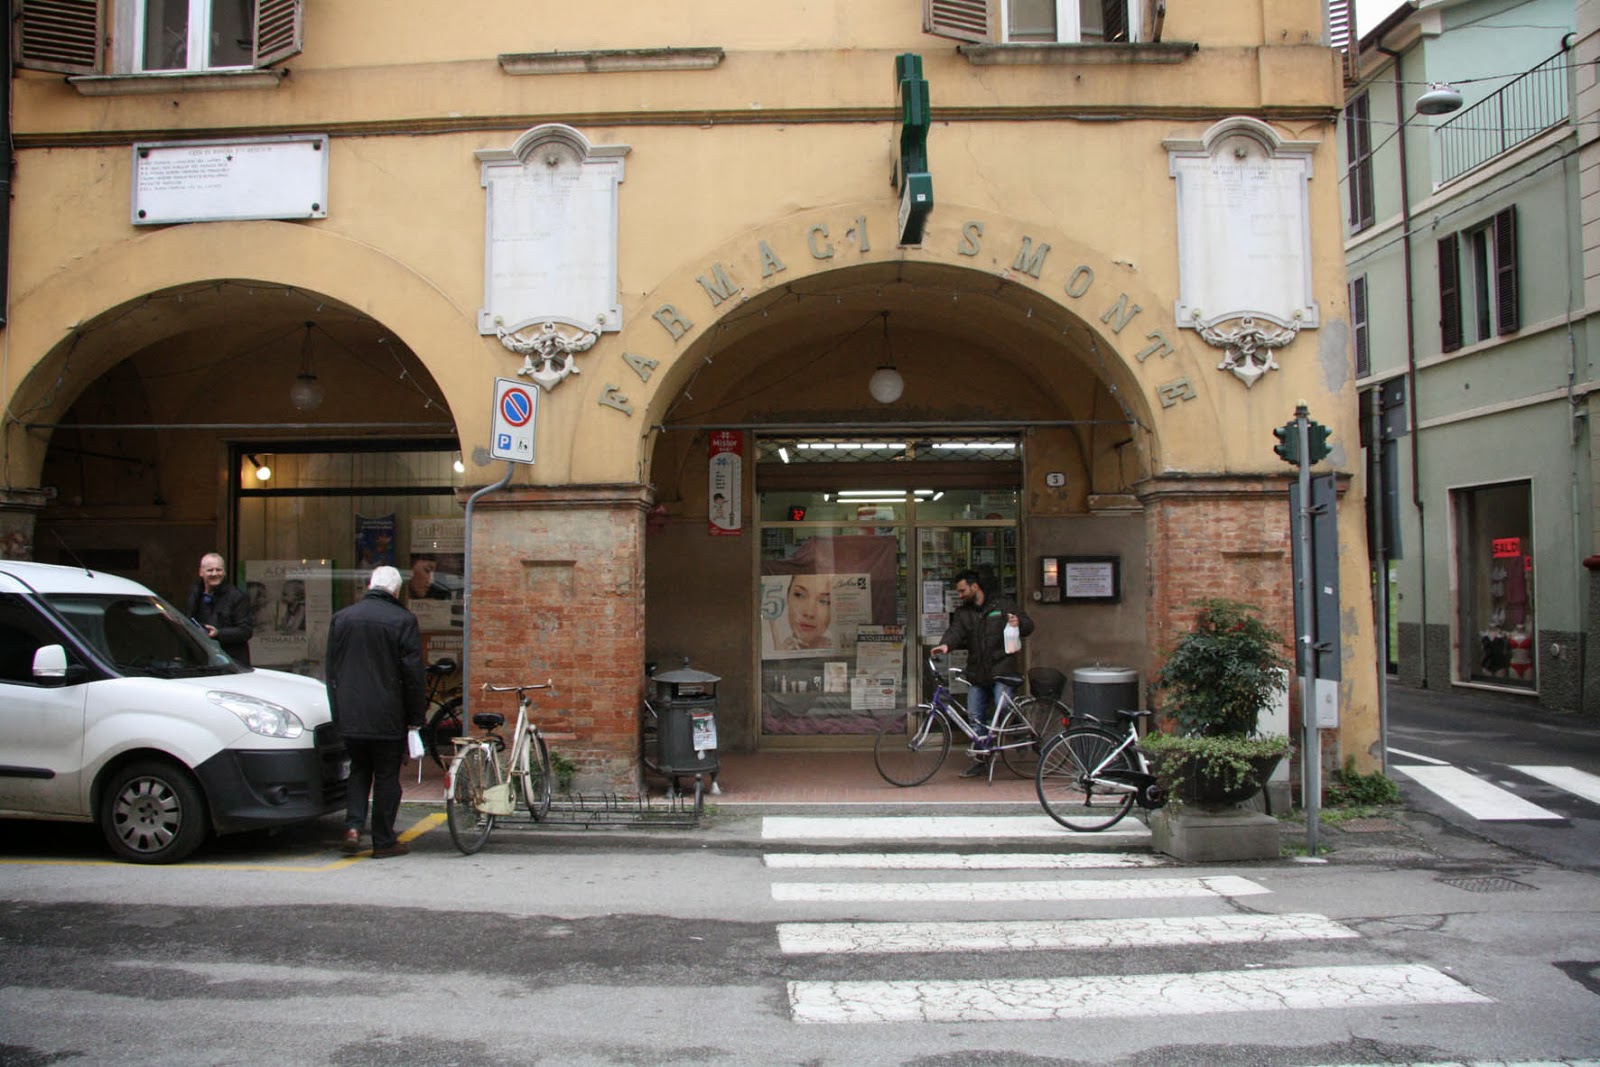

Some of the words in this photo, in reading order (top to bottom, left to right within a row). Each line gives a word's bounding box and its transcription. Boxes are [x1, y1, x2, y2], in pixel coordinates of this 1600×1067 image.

[598, 215, 922, 418] FARMACI
[1011, 235, 1197, 409] MONTE
[500, 435, 510, 448] P
